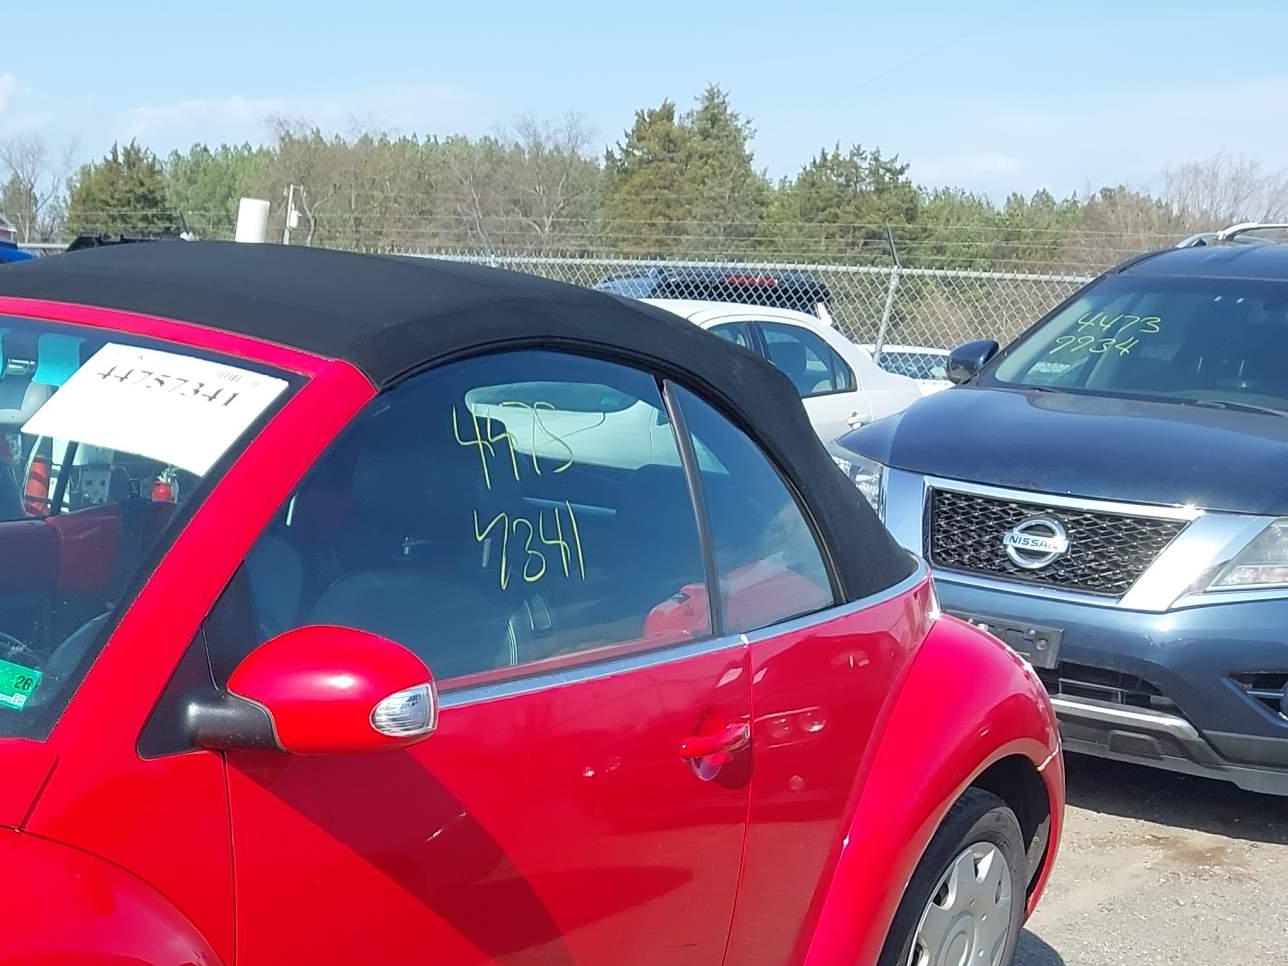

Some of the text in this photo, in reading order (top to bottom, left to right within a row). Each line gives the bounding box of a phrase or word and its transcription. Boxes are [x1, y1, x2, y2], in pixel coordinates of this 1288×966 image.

[1076, 311, 1162, 333] 4473
[96, 364, 240, 407] 44757341
[12, 674, 34, 692] 26
